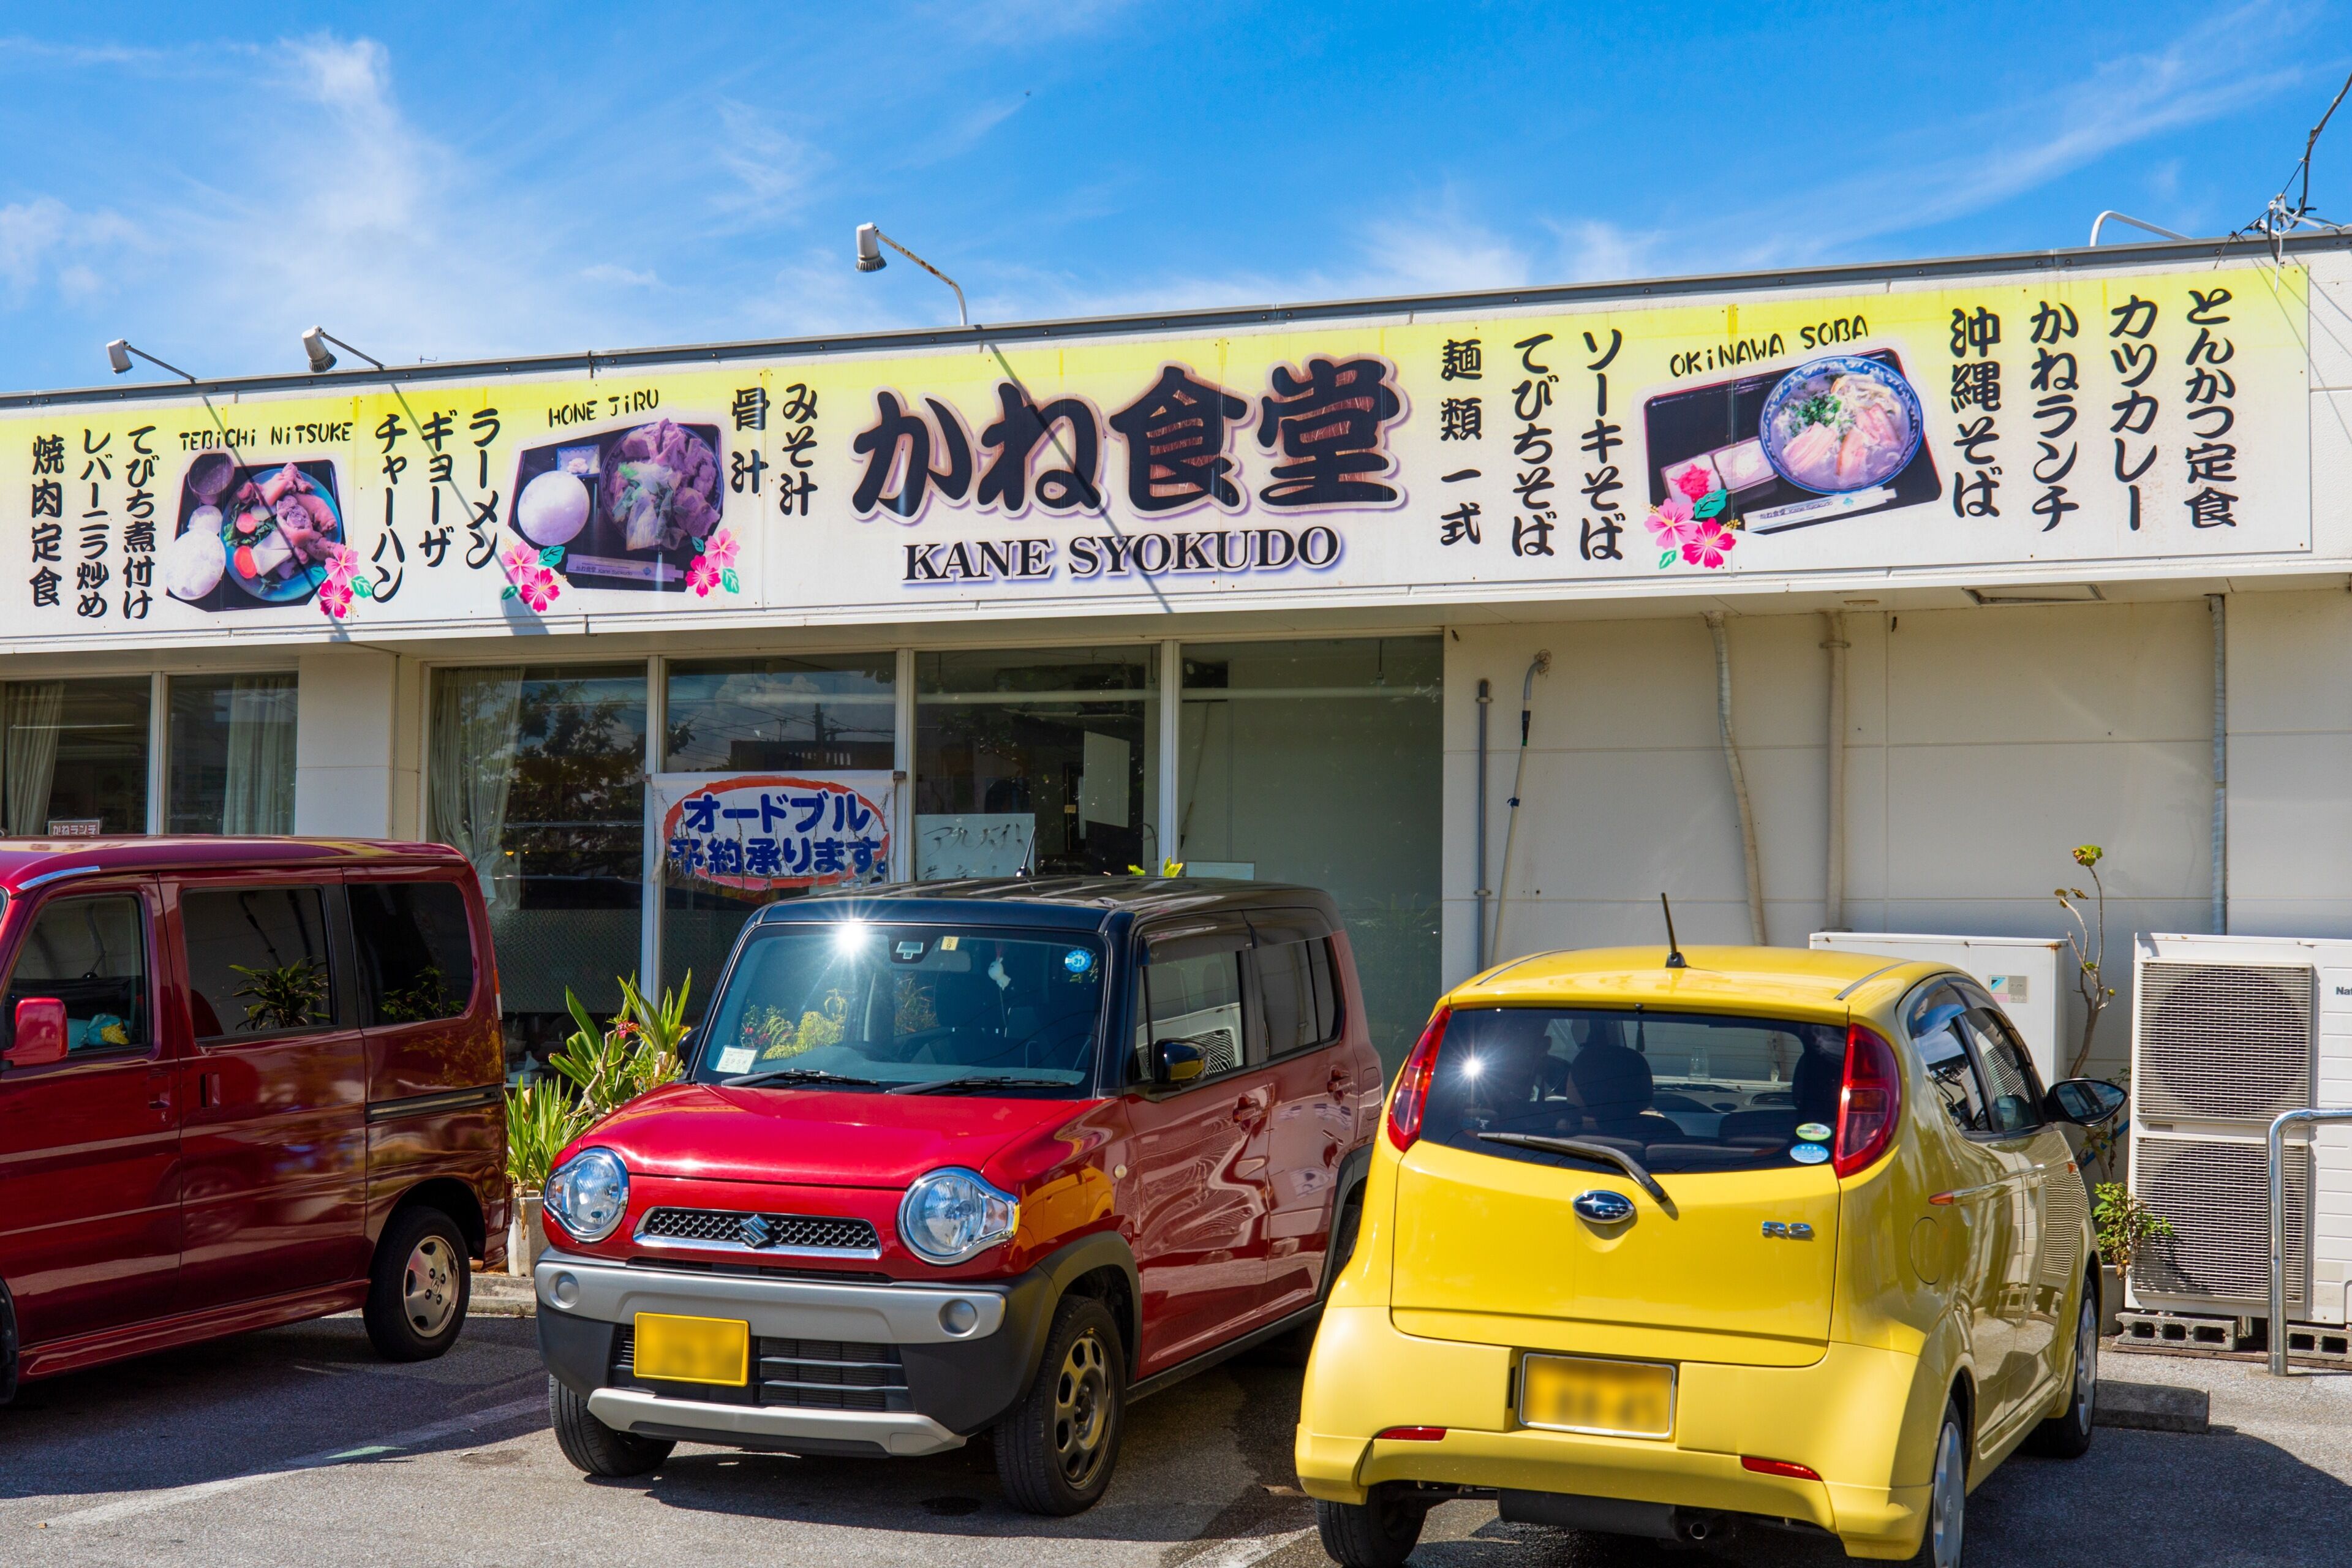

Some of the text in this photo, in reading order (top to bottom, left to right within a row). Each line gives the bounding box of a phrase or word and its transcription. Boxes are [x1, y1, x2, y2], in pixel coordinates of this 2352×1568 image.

[549, 401, 597, 428] HONE
[1800, 315, 1868, 347] SOBA
[1950, 306, 2002, 518] 沖縄そば
[2109, 295, 2158, 530] カツカレー
[2184, 288, 2237, 529] とんかつ定食
[419, 410, 457, 567] ギョーザ
[467, 408, 500, 570] ラーメン
[731, 388, 769, 494] 骨汁
[780, 383, 818, 516] みそ汁
[852, 358, 1400, 516] かね食堂
[1441, 339, 1482, 546] 麺類一式
[1512, 334, 1559, 557] てびちそば
[1581, 329, 1625, 560] ソーキそば
[2030, 301, 2079, 532] かねランチ
[29, 434, 64, 607] 焼肉定食
[77, 429, 112, 618] レバーニラ炒め
[123, 426, 159, 619] てびち煮付け
[372, 414, 407, 603] チャーハン
[903, 527, 1338, 581] KANE SYOKUDO
[669, 837, 886, 875] 予約承ります。
[684, 790, 870, 833] オードブル
[1762, 1221, 1811, 1239] R2
